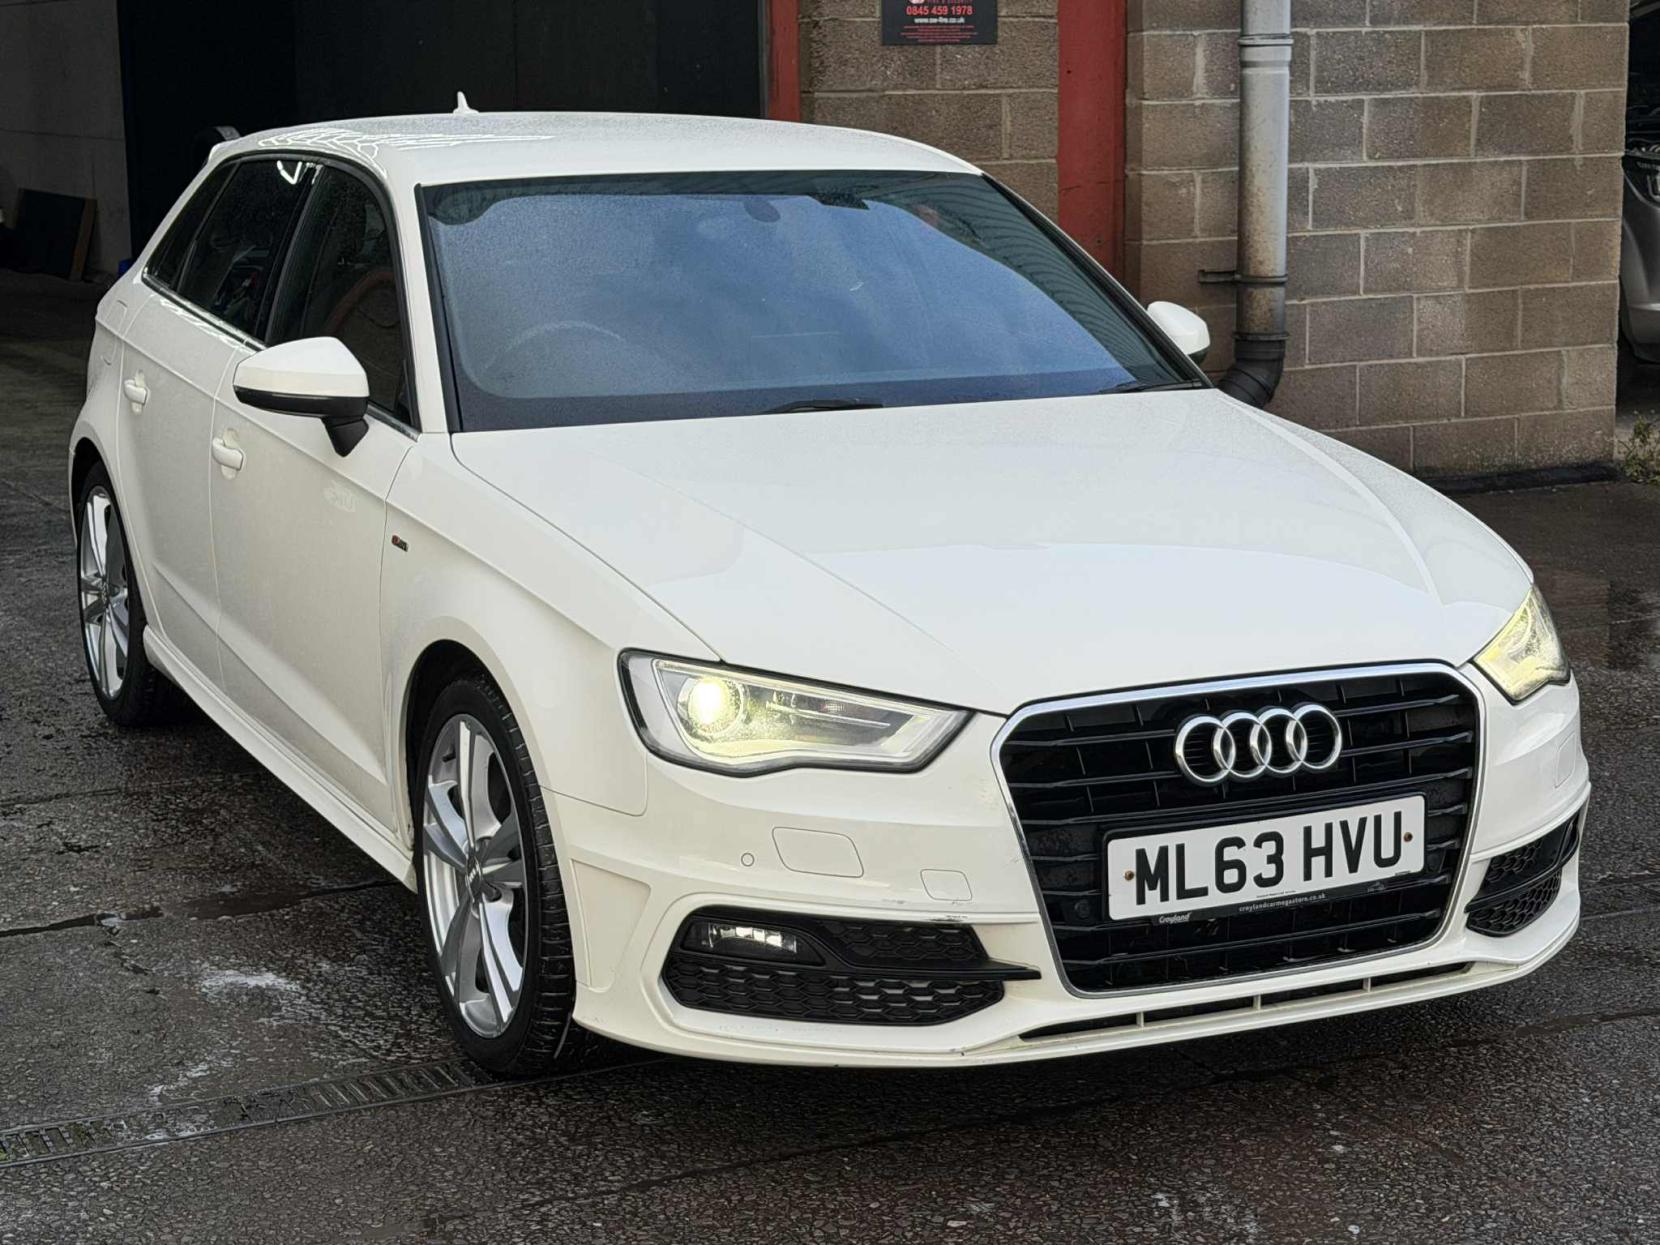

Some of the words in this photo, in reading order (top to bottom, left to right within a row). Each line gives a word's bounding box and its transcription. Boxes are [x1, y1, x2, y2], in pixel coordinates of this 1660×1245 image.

[906, 5, 929, 16] 0845
[931, 5, 948, 16] 459
[951, 5, 973, 16] 1978
[1135, 831, 1284, 906] ML63
[1303, 811, 1402, 882] HVU
